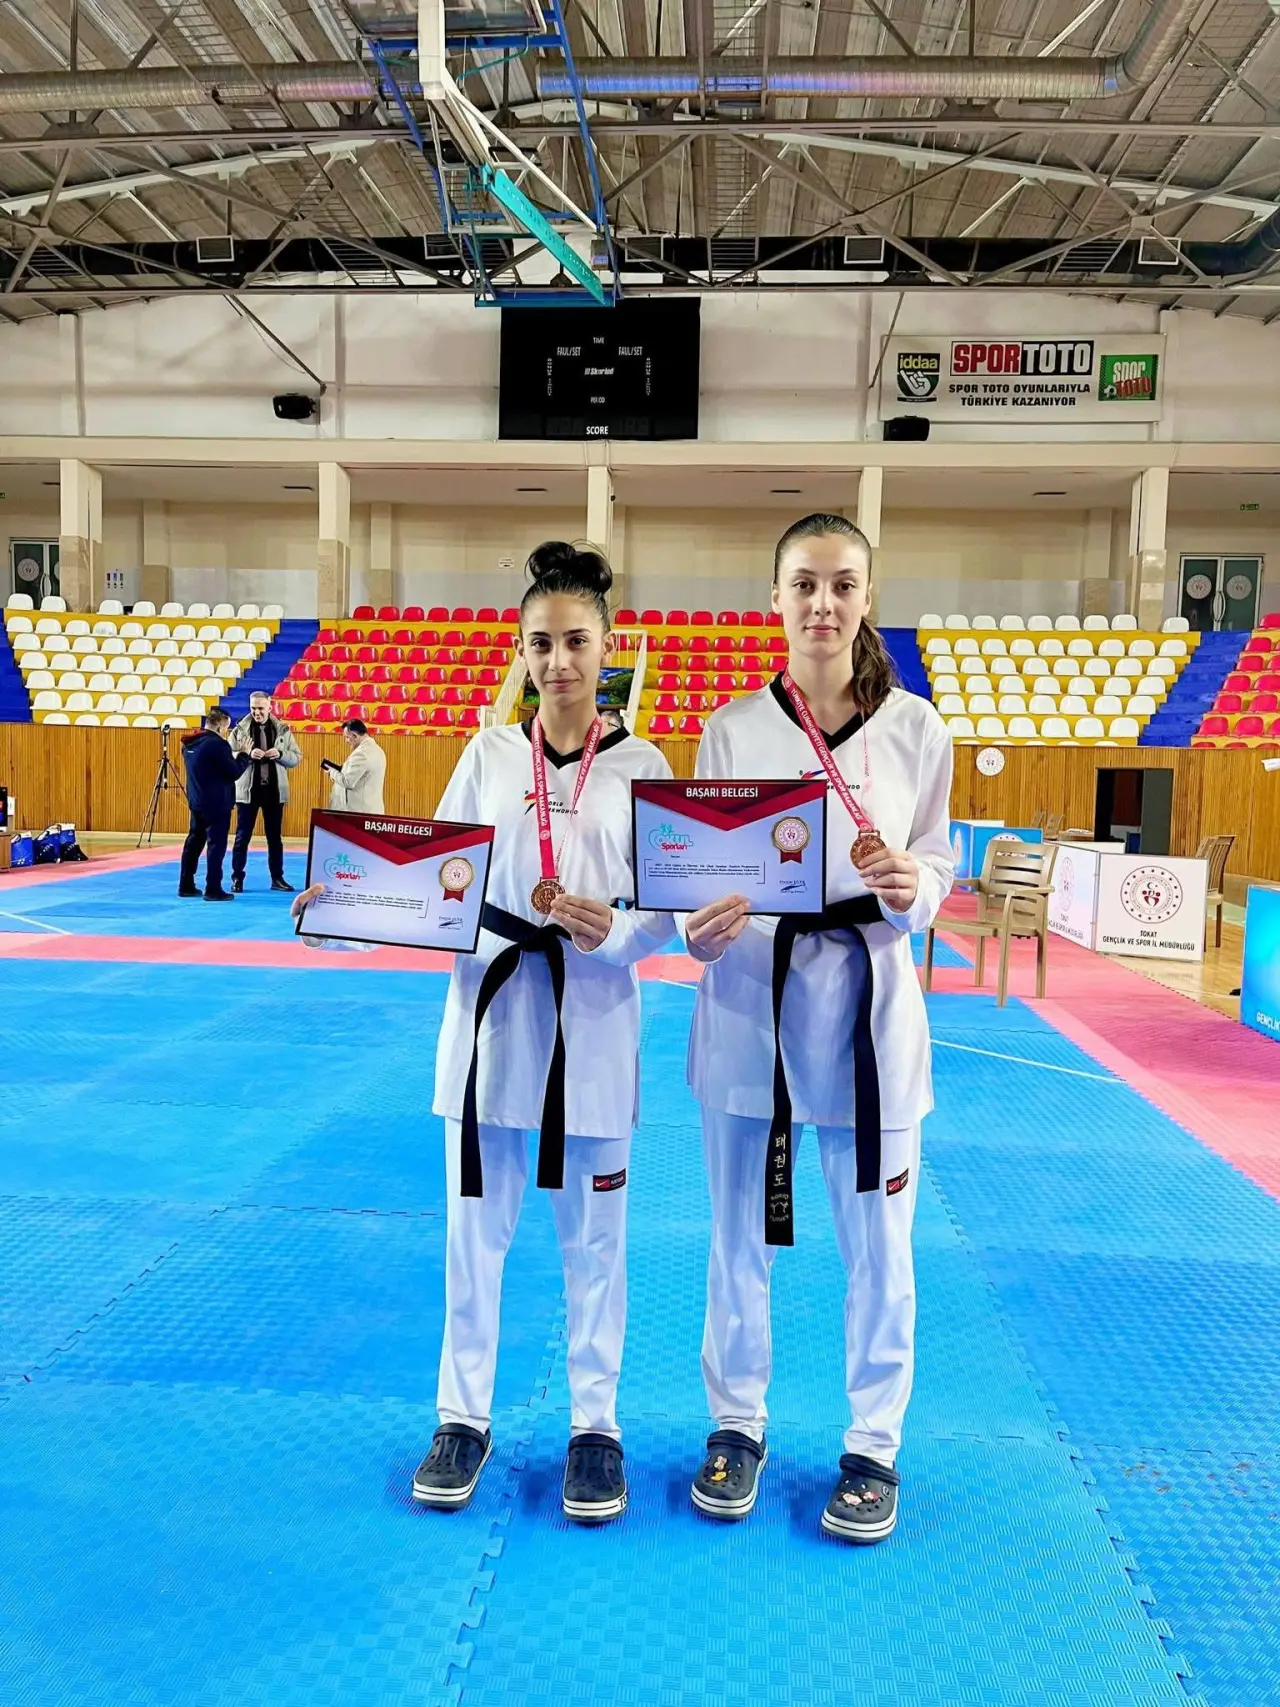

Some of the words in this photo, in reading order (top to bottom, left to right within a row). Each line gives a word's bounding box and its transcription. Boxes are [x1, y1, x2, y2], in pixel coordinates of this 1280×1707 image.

[556, 346, 581, 356] FAUL/SET
[618, 346, 643, 356] FAUL/SET
[900, 355, 938, 369] iddaa
[949, 384, 978, 393] SPOR
[983, 383, 1010, 393] TOTO
[1014, 382, 1090, 394] OYUNLARIYLA
[961, 395, 1007, 406] TÜRKİYE
[1011, 396, 1076, 406] KAZANIYOR
[586, 426, 609, 435] SCORE
[686, 787, 719, 799] BAŞARI
[721, 786, 758, 798] BELGESİ
[364, 820, 396, 834] BAŞARI
[397, 826, 432, 837] BELGESİ
[1140, 930, 1157, 938] TOKAT
[1102, 935, 1126, 945] GENÇLİK
[1136, 938, 1151, 947] SPOR
